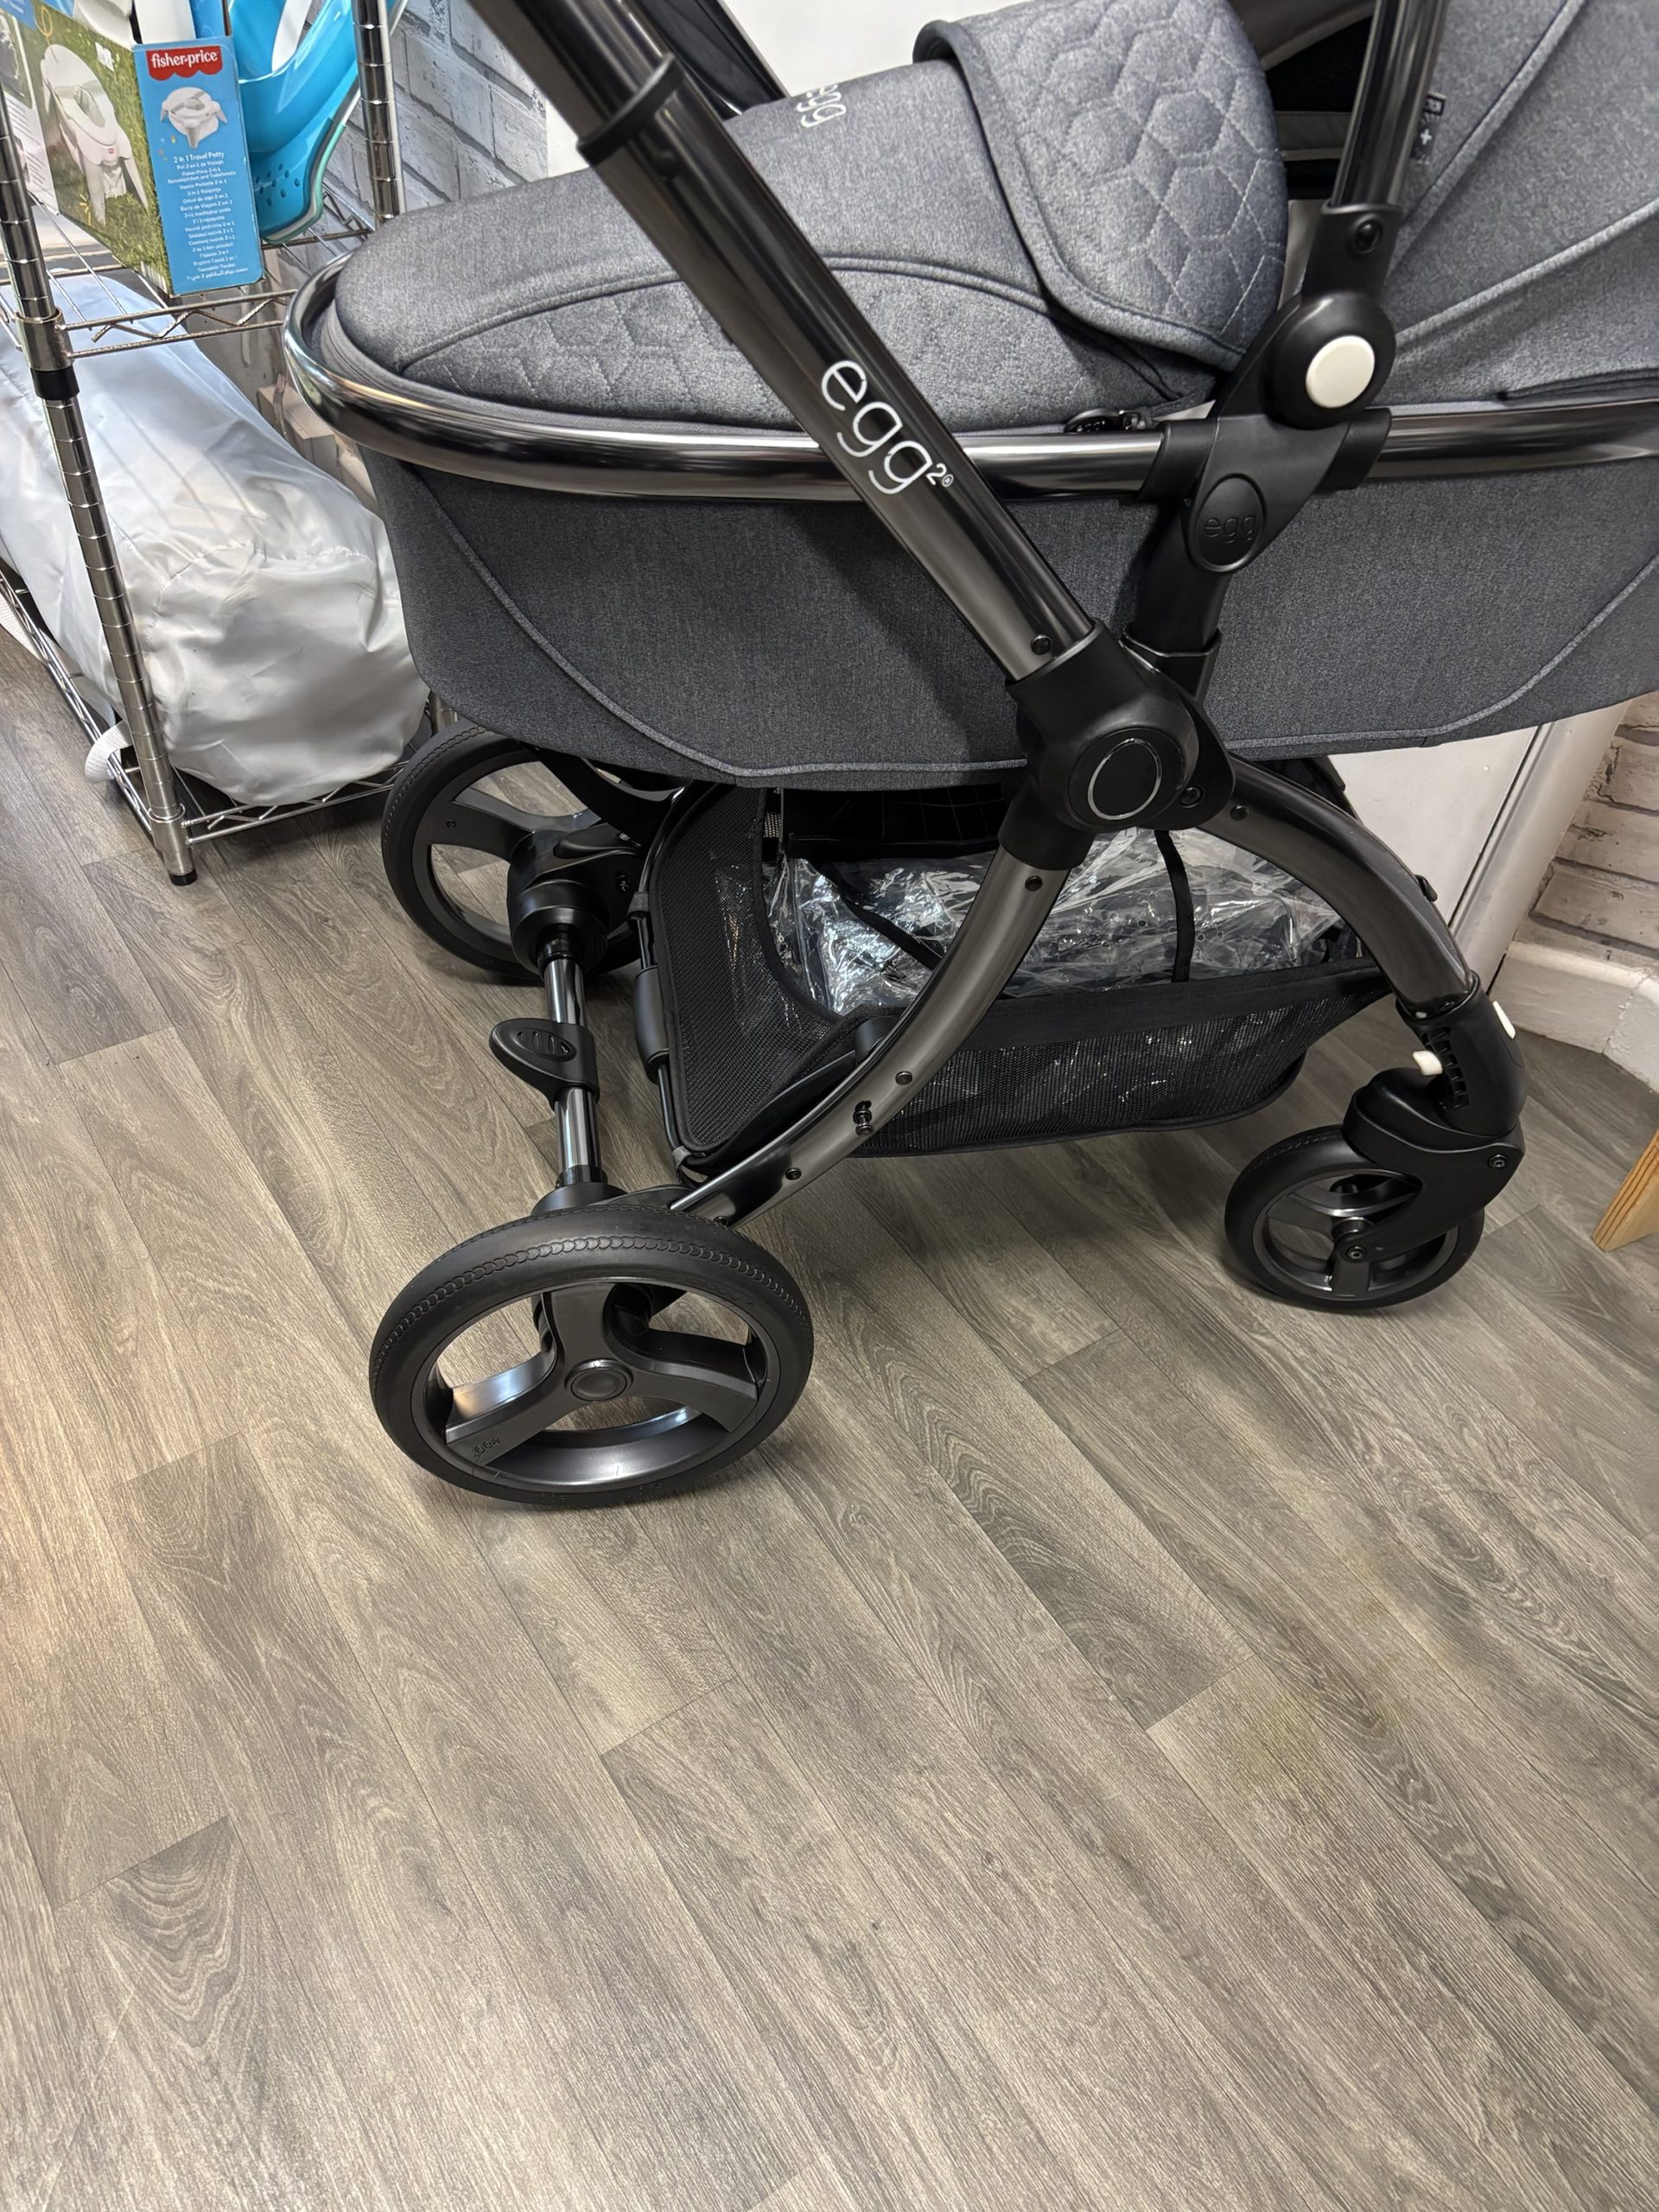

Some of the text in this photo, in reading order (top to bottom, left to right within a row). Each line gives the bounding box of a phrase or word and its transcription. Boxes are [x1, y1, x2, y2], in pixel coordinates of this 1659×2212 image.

[150, 50, 218, 69] fisher-price
[189, 152, 207, 161] Travel
[1204, 516, 1256, 543] egg
